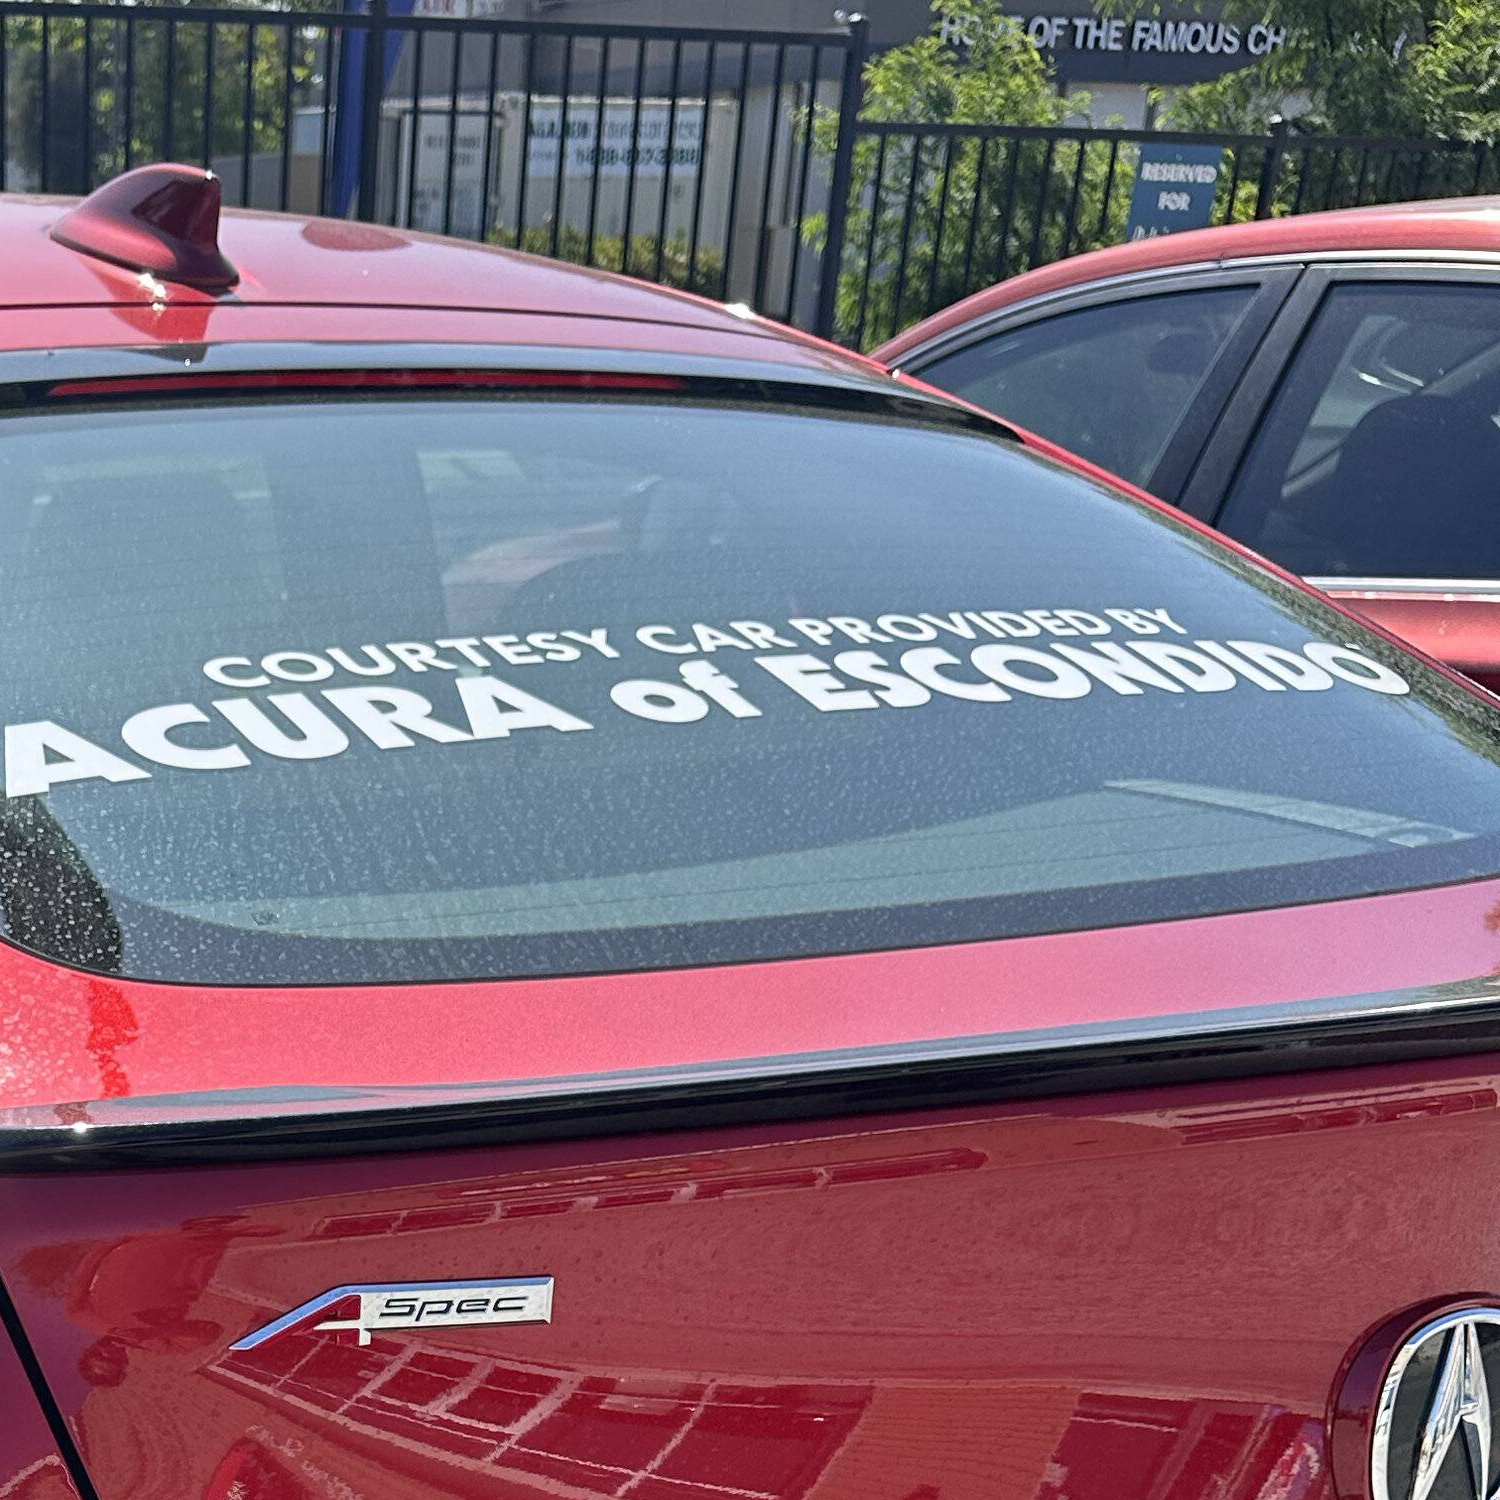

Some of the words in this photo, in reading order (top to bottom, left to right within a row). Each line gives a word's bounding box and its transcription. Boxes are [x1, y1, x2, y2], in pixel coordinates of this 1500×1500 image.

[1027, 15, 1070, 49] OF
[1072, 18, 1126, 51] THE
[1131, 20, 1240, 54] FAMOUS
[1141, 162, 1218, 183] RESERVED
[1158, 191, 1191, 211] FOR
[203, 627, 620, 688] COURTESY
[635, 620, 797, 655] CAR
[789, 608, 1113, 647] PROVIDED
[1105, 607, 1189, 635] BY
[5, 676, 594, 798] ACURA
[610, 660, 762, 723] of
[754, 640, 1411, 712] ESCONDIDO
[379, 1297, 529, 1322] Spec
